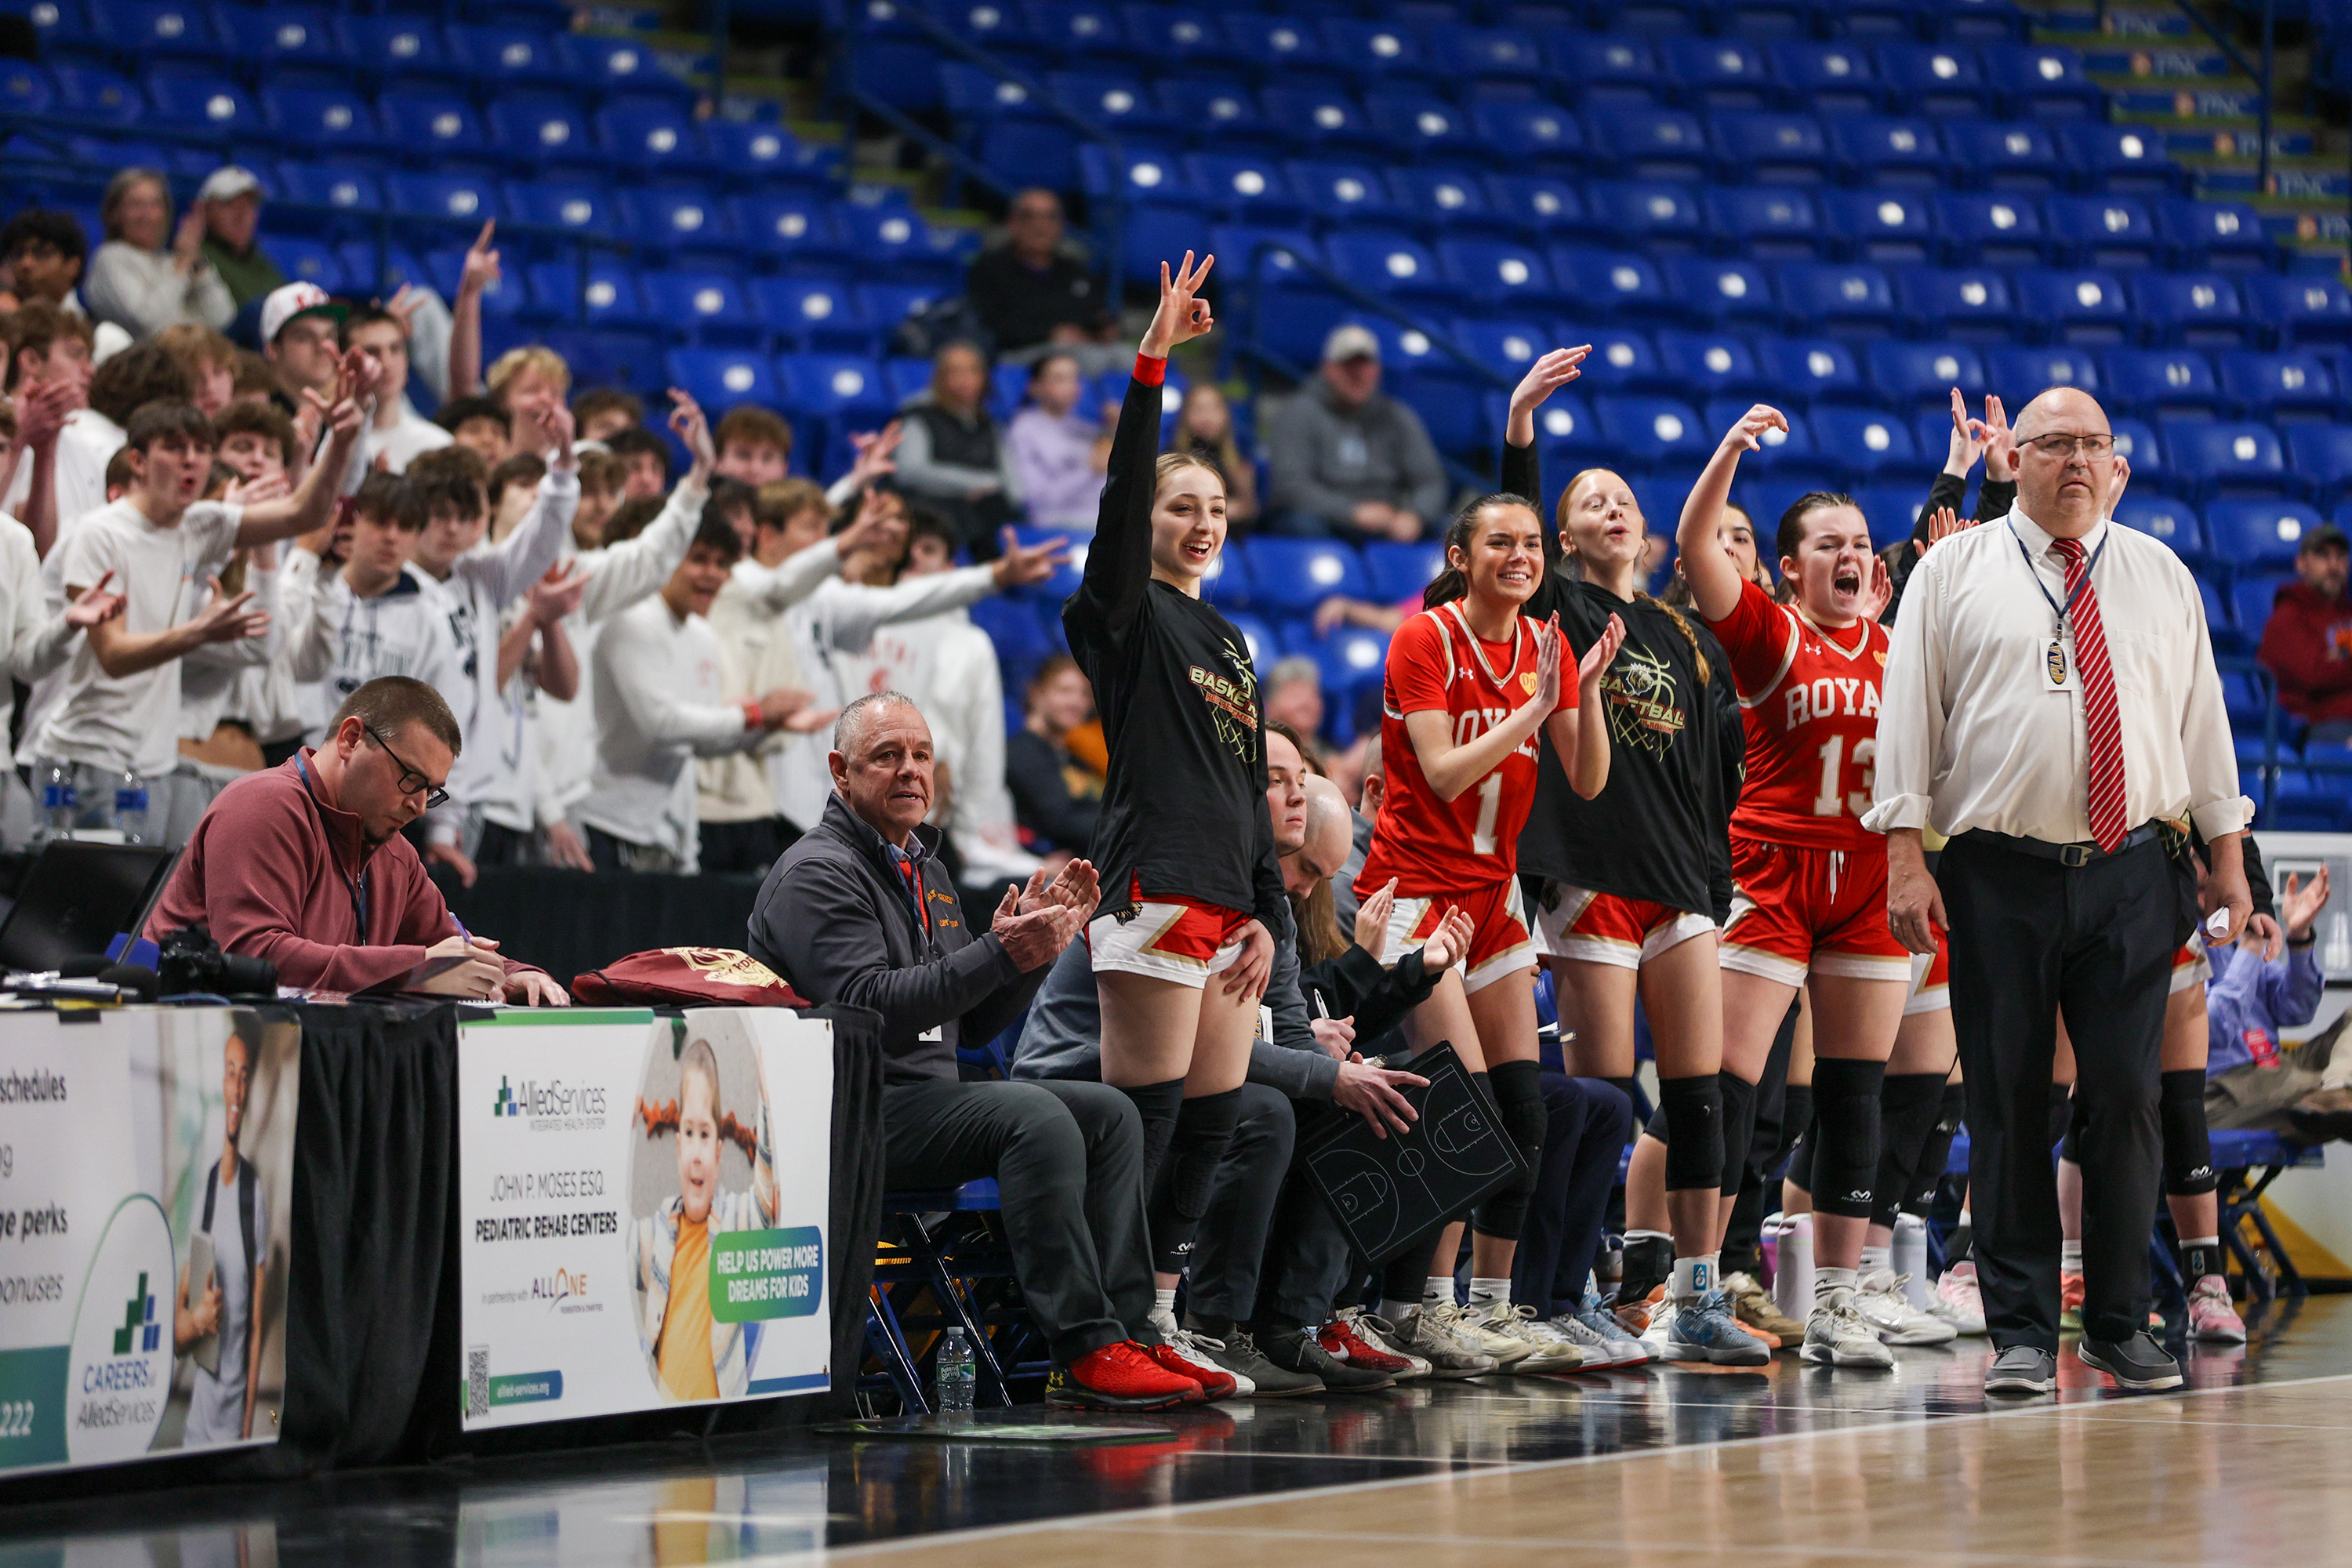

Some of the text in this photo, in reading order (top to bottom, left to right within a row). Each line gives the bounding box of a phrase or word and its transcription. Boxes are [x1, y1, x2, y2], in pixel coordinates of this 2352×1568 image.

[2049, 645, 2066, 681] PIAA
[1471, 771, 1504, 855] 1
[490, 1171, 606, 1202] JOHN P. MOSES ESQ.
[21, 1200, 68, 1243] perks
[476, 1210, 618, 1243] PEDIATRIC REHAB CENTERS
[717, 1243, 819, 1274] HELP US POWER MORE
[728, 1273, 809, 1303] DREAMS FOR KIDS
[84, 1359, 149, 1394] CAREERS
[941, 1364, 960, 1374] Poland
[941, 1371, 960, 1381] Spring
